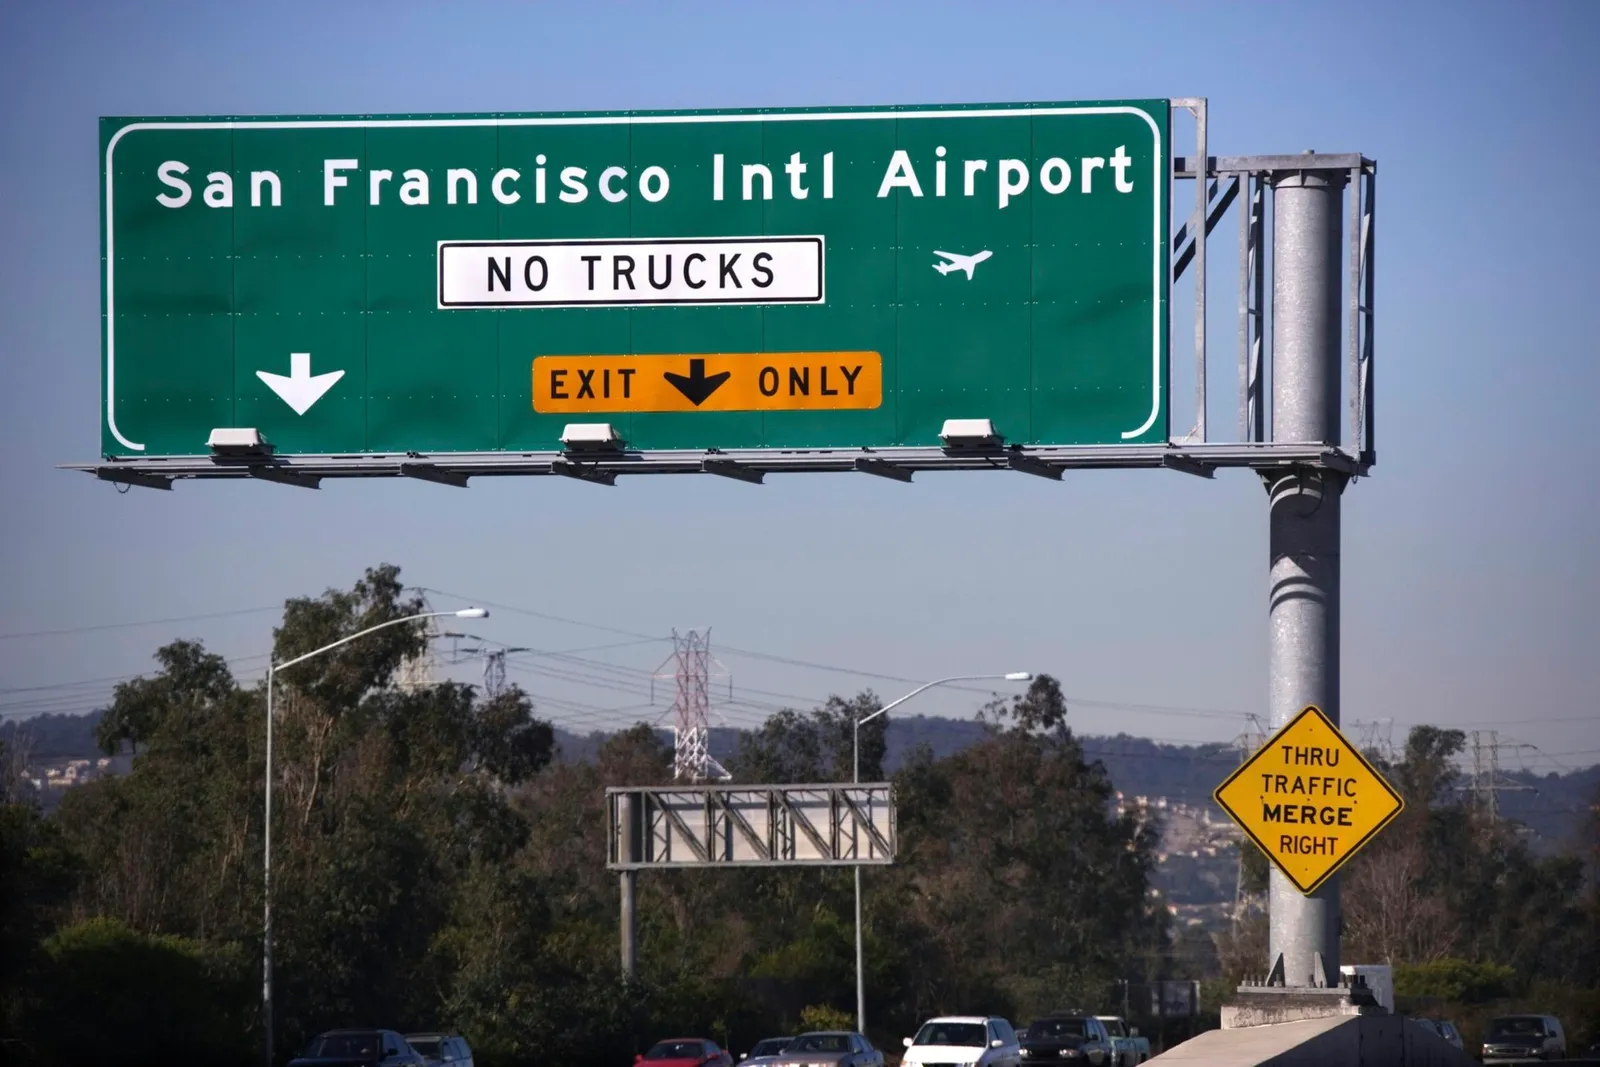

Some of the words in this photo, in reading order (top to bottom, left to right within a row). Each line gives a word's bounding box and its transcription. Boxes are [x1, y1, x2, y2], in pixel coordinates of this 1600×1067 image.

[155, 160, 282, 209] San
[323, 153, 670, 207] Francisco
[713, 151, 834, 201] Intl
[876, 145, 1134, 210] Airport
[487, 255, 549, 292] NO
[580, 252, 775, 291] TRUCKS
[550, 368, 636, 400] EXIT
[758, 365, 864, 397] ONLY
[1281, 745, 1340, 767] THRU
[1261, 773, 1358, 798] TRAFFIC
[1262, 803, 1354, 827] MERGE
[1279, 834, 1339, 856] RIGHT
